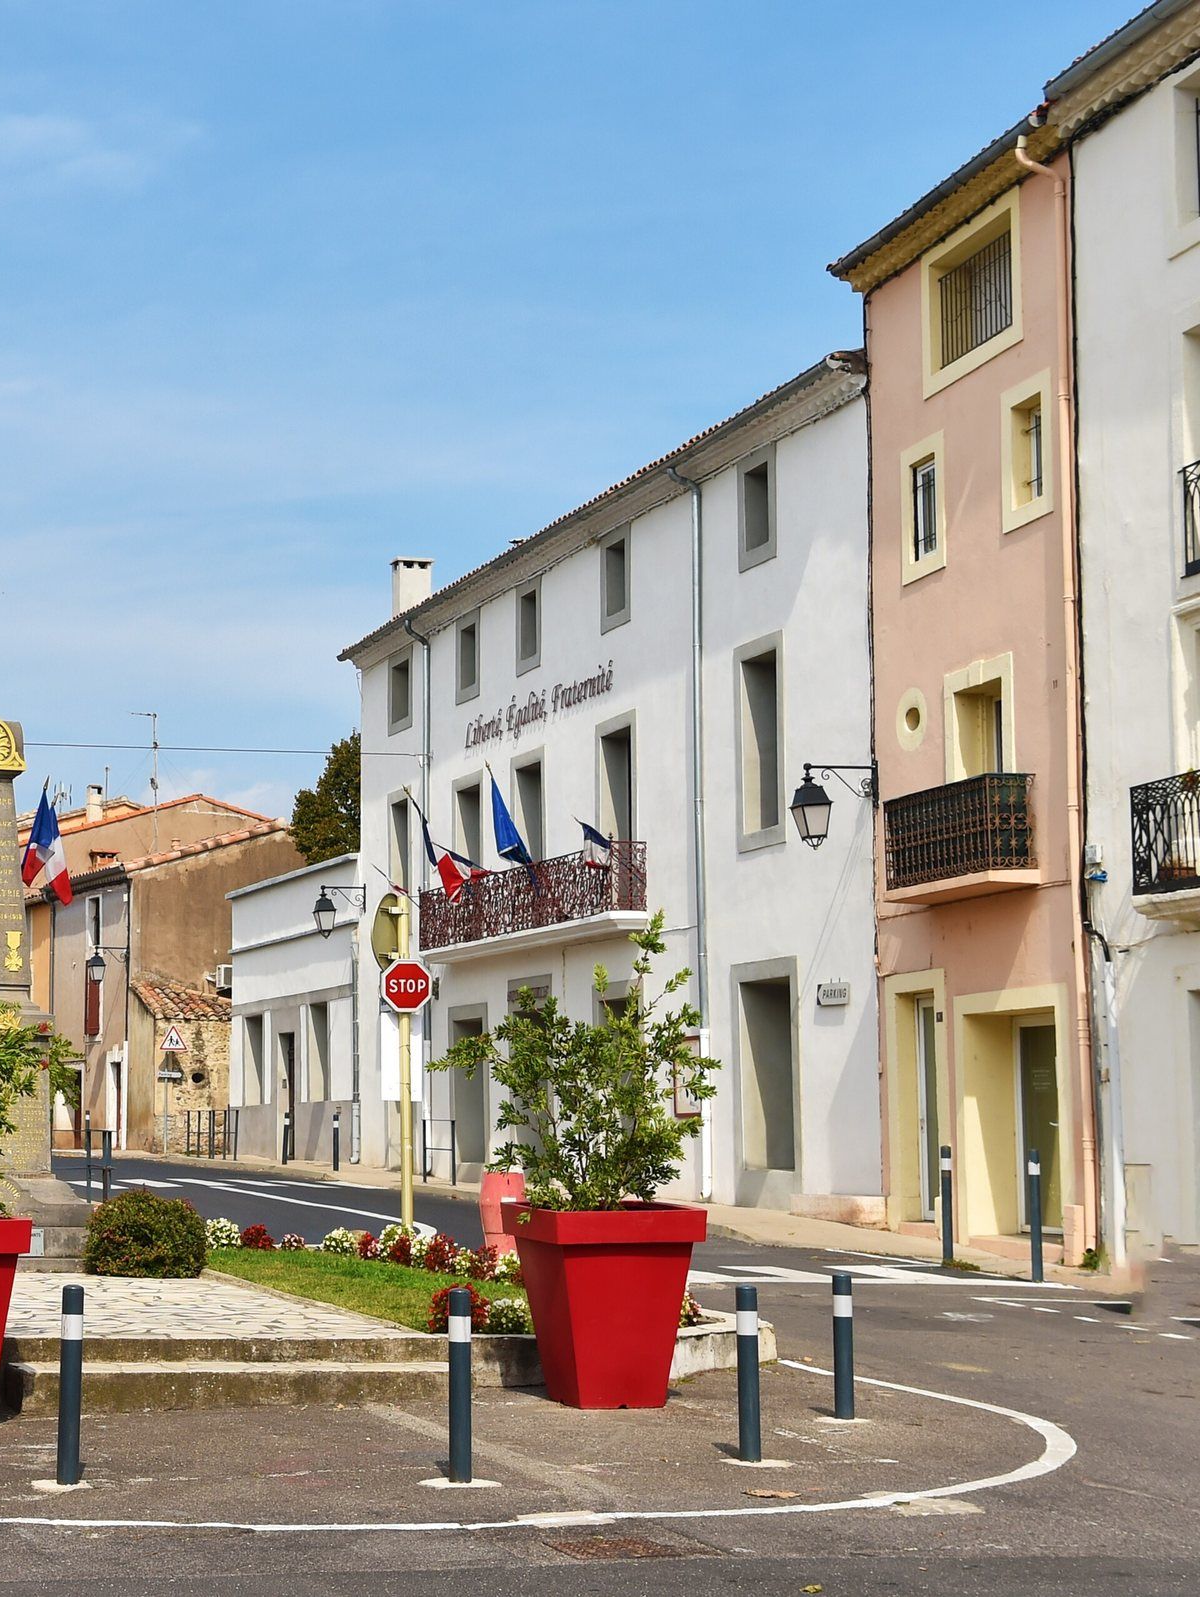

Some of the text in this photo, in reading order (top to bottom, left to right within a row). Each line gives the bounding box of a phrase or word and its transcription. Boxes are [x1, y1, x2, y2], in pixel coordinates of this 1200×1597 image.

[551, 659, 614, 713] Fraternité
[389, 978, 427, 994] STOP
[822, 988, 847, 999] PARKING
